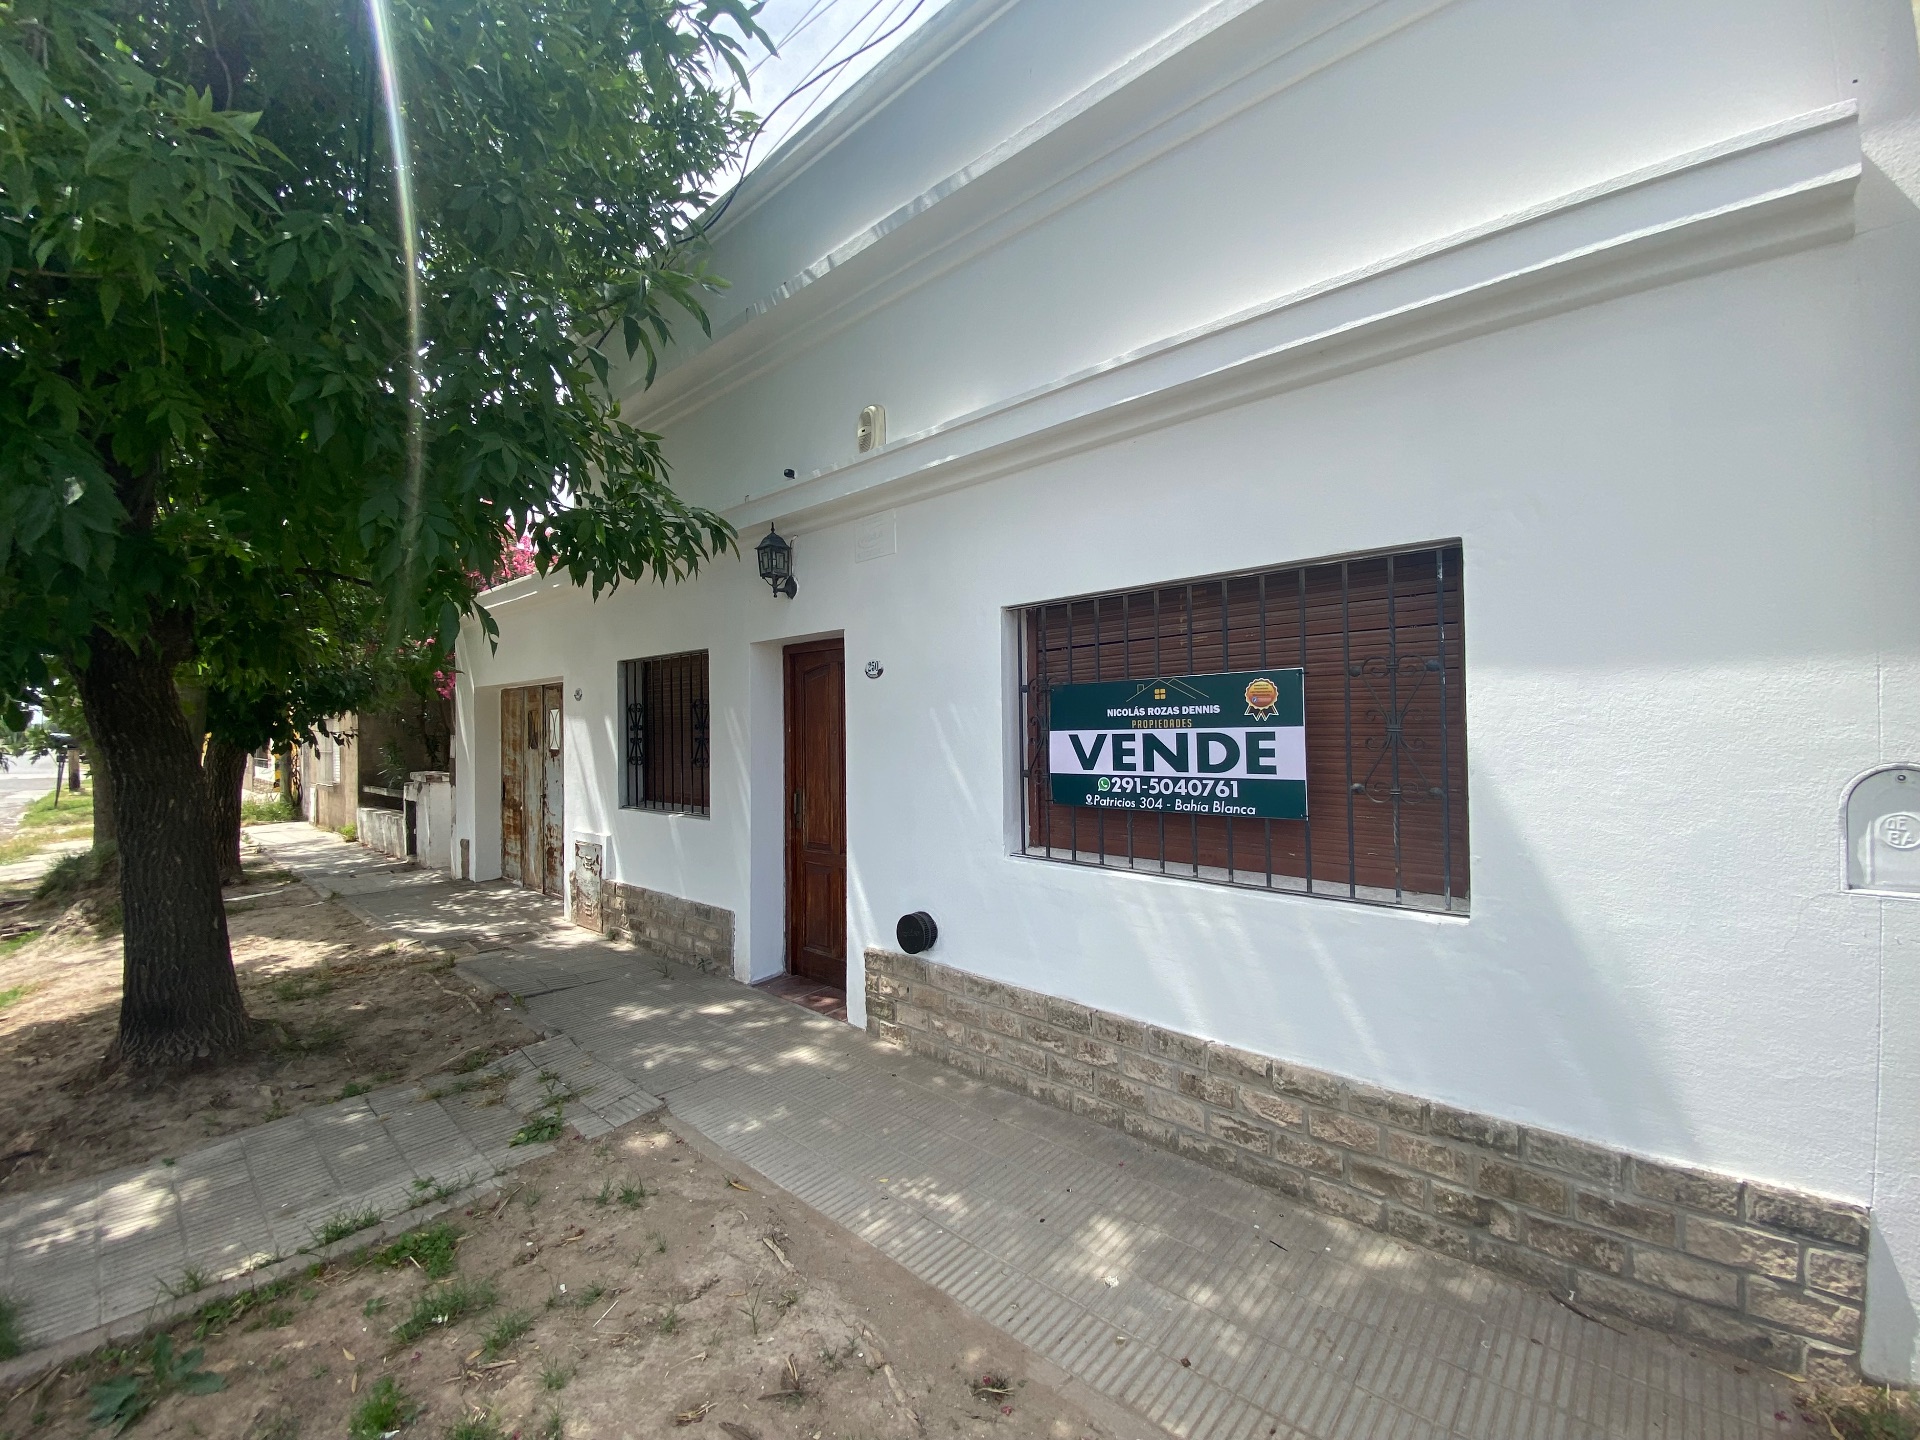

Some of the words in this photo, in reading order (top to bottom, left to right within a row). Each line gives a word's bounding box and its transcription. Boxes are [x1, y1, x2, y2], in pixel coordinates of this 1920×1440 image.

[1107, 706, 1145, 717] NICOLÁS
[1147, 706, 1180, 716] ROZAS
[1181, 705, 1220, 715] DENNIS
[1131, 719, 1192, 729] PROPIEDADES
[1068, 731, 1277, 775] VENDE
[1111, 777, 1238, 798] 291-5040761
[1093, 796, 1135, 808] Patricios
[1139, 798, 1162, 810] 304
[1175, 799, 1210, 812] Bahía
[1212, 801, 1256, 815] Blanca
